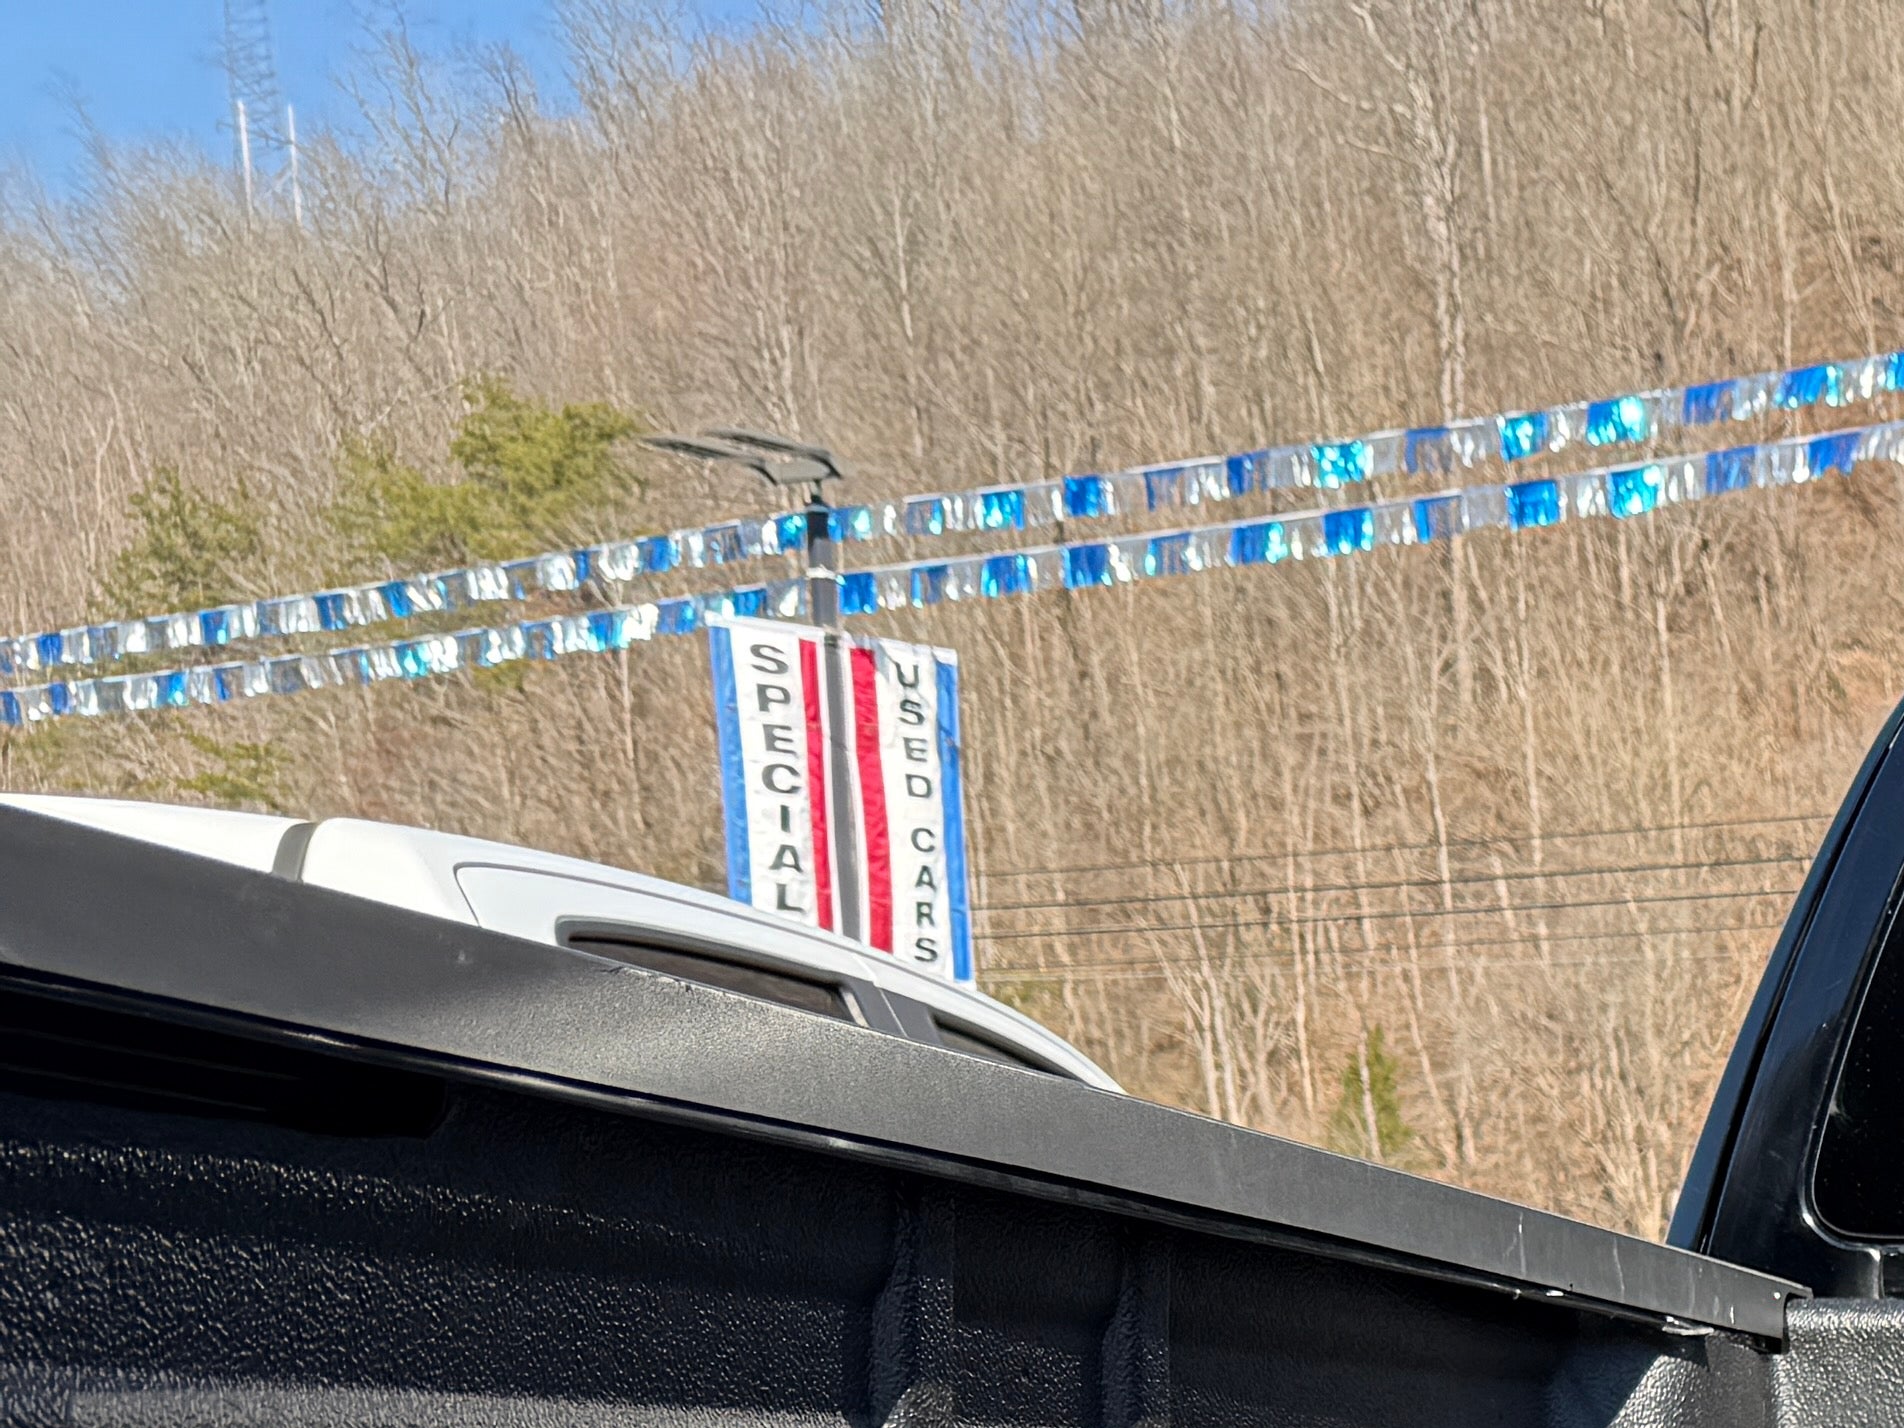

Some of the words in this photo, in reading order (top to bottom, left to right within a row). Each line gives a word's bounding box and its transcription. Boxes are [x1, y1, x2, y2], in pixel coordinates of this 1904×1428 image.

[749, 643, 806, 915] SPECIAL
[896, 661, 932, 799] USED
[910, 827, 938, 963] CARS
